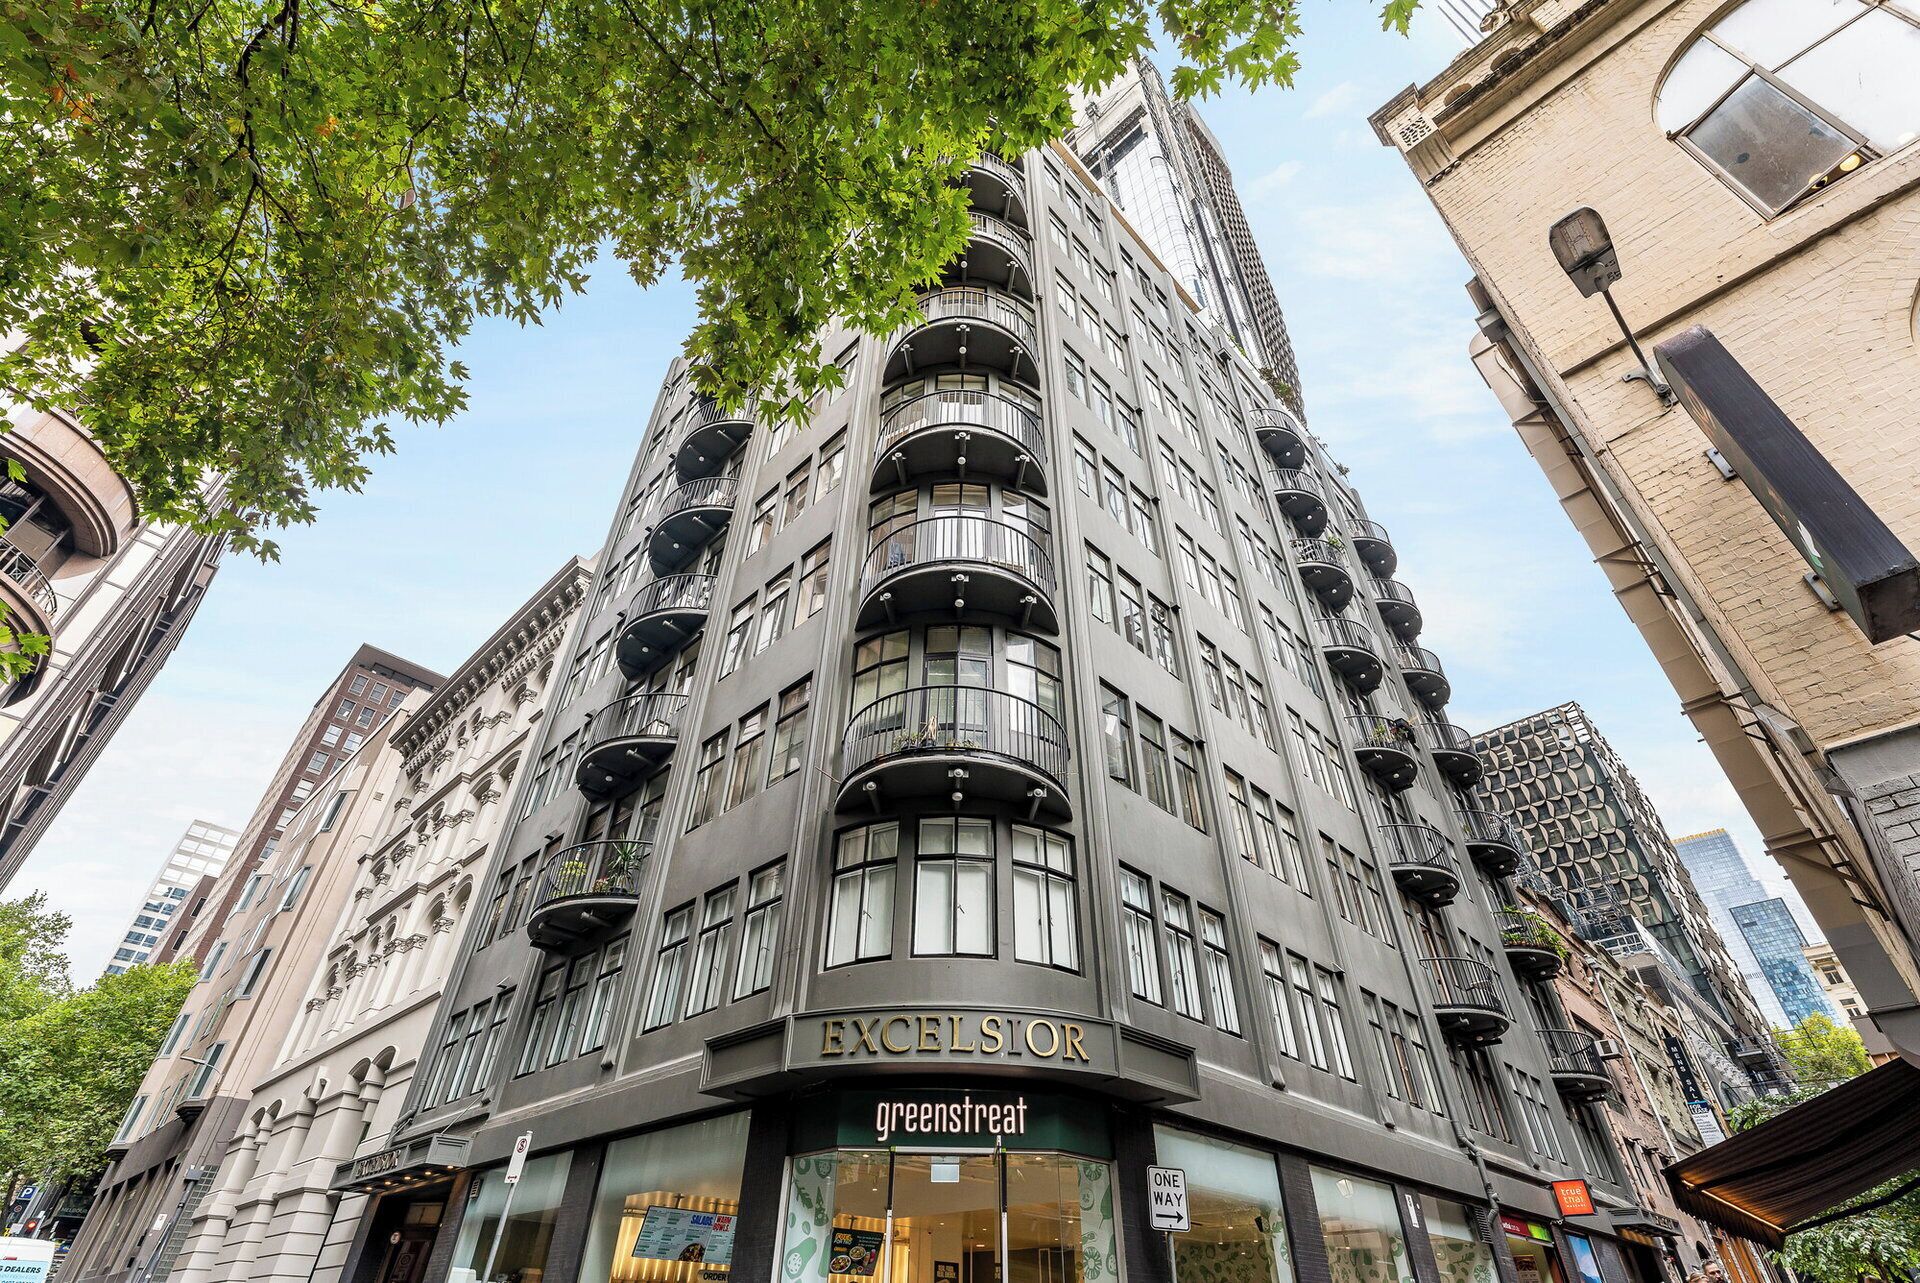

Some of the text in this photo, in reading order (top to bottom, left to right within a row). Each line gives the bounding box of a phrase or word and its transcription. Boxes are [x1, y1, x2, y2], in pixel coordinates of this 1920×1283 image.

[822, 1014, 1090, 1062] EXCELSIOR
[1670, 1046, 1686, 1073] MENS
[876, 1096, 1027, 1142] greenstreat
[1154, 1172, 1180, 1188] ONE
[1153, 1191, 1183, 1207] WAY
[1560, 1187, 1581, 1196] true
[1563, 1195, 1584, 1204] thai
[4, 1265, 41, 1274] DEALERS
[703, 1272, 727, 1282] ORDER
